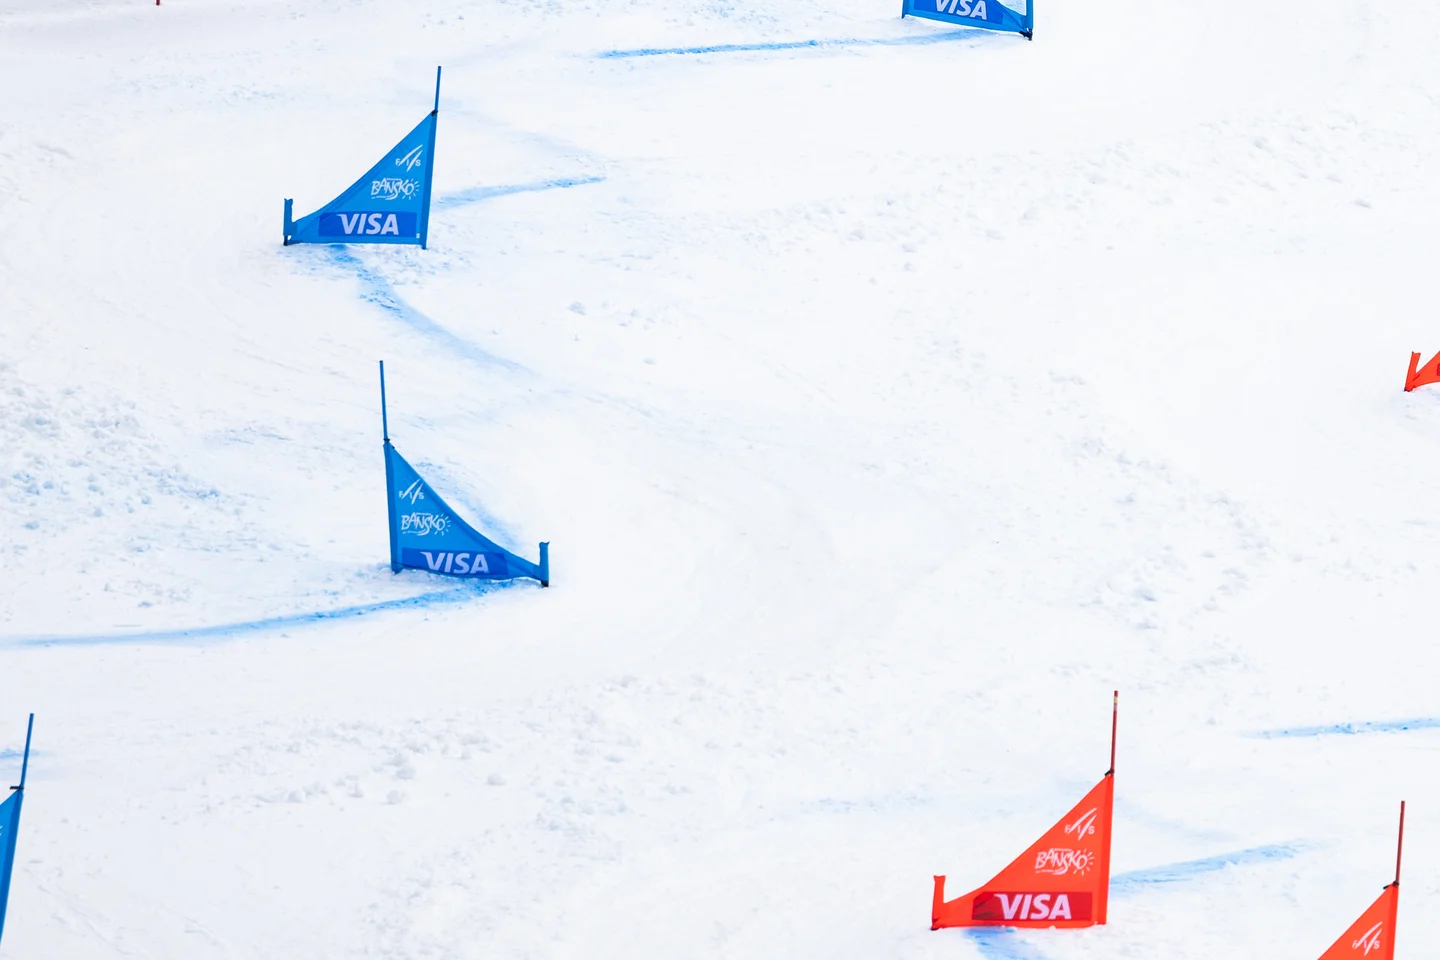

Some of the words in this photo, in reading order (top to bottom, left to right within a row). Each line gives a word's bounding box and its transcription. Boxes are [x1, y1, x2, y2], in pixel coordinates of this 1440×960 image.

[336, 213, 400, 236] VISA
[420, 552, 489, 574] VISA
[994, 894, 1072, 920] VISA
